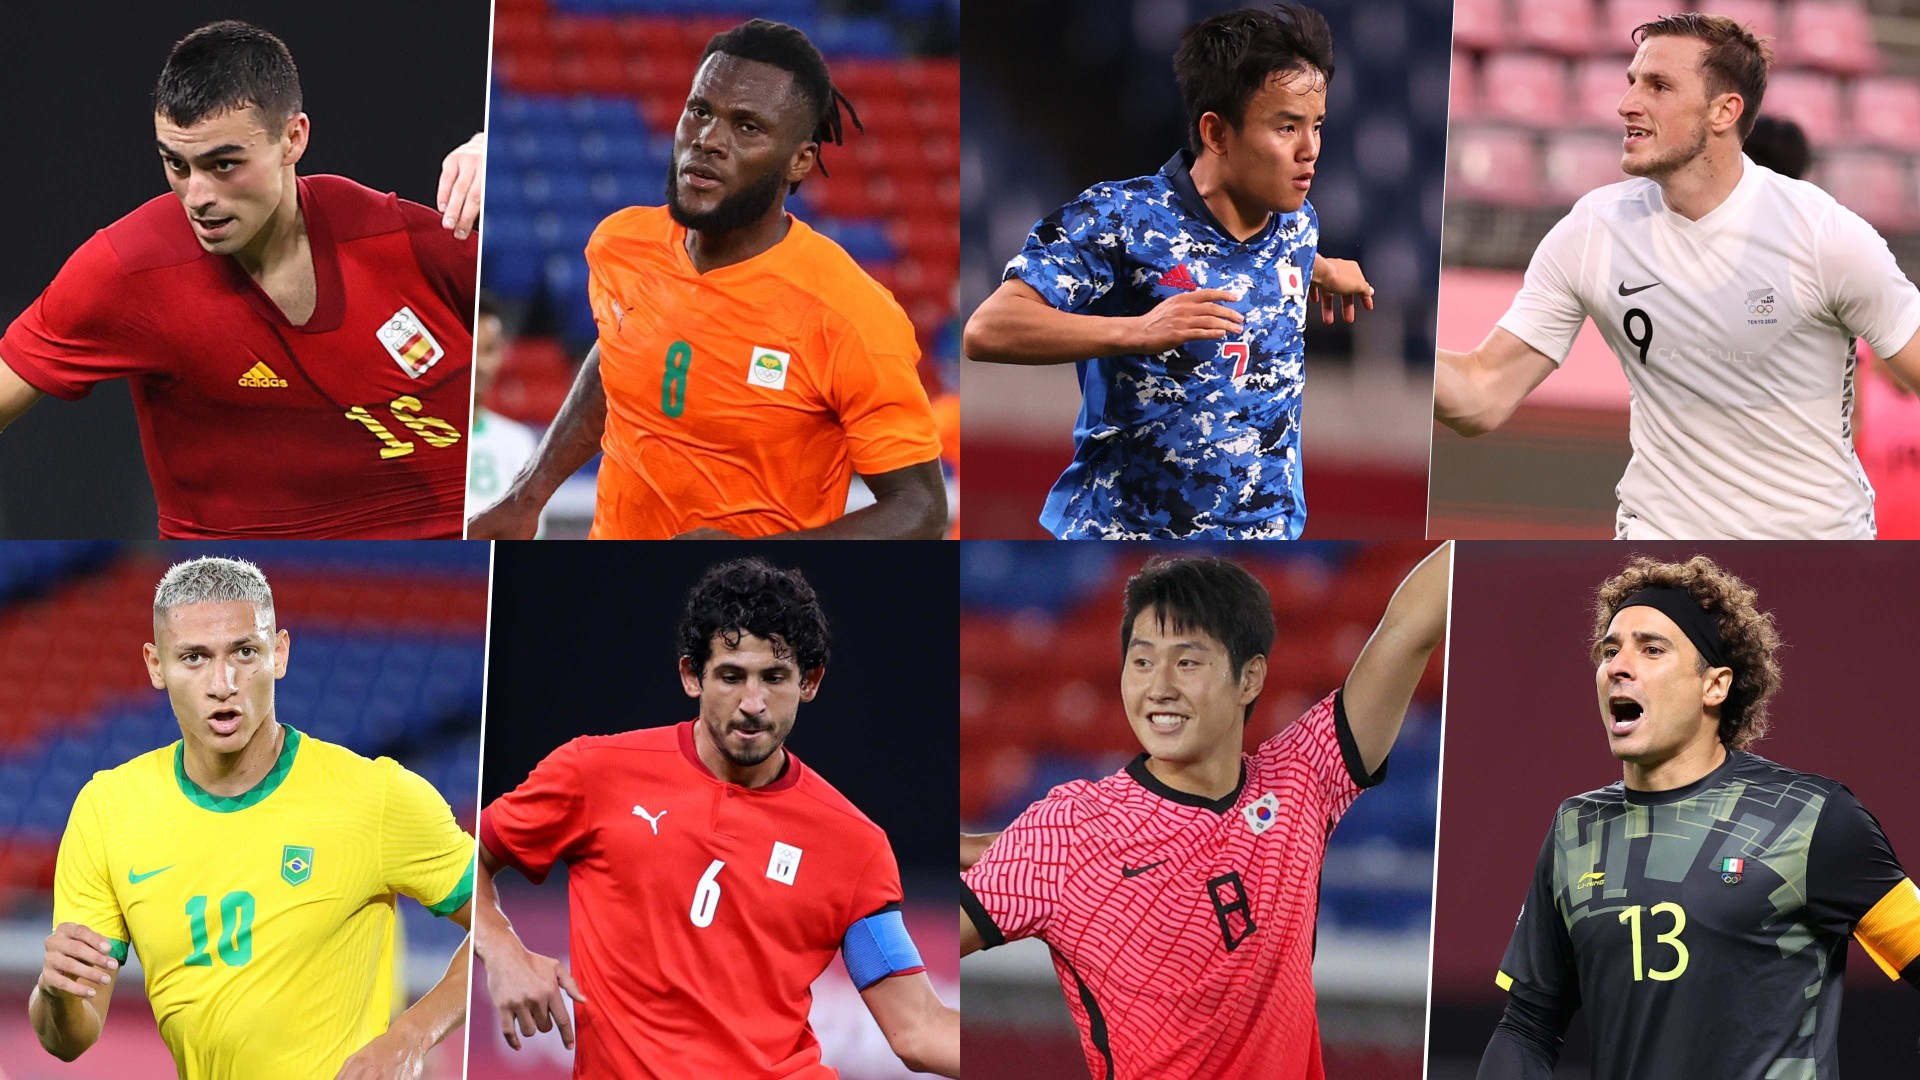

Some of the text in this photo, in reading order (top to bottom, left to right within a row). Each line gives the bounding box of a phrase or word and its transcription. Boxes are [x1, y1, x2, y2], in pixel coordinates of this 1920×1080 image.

[1222, 342, 1249, 381] 7
[1623, 308, 1653, 365] 9
[1656, 347, 1754, 364] CAAPULT
[238, 378, 288, 388] adidas
[661, 341, 692, 418] 8
[345, 395, 461, 459] 16
[689, 858, 726, 929] 6
[1206, 870, 1258, 952] 8
[183, 890, 256, 967] 10
[1618, 902, 1690, 981] 13
